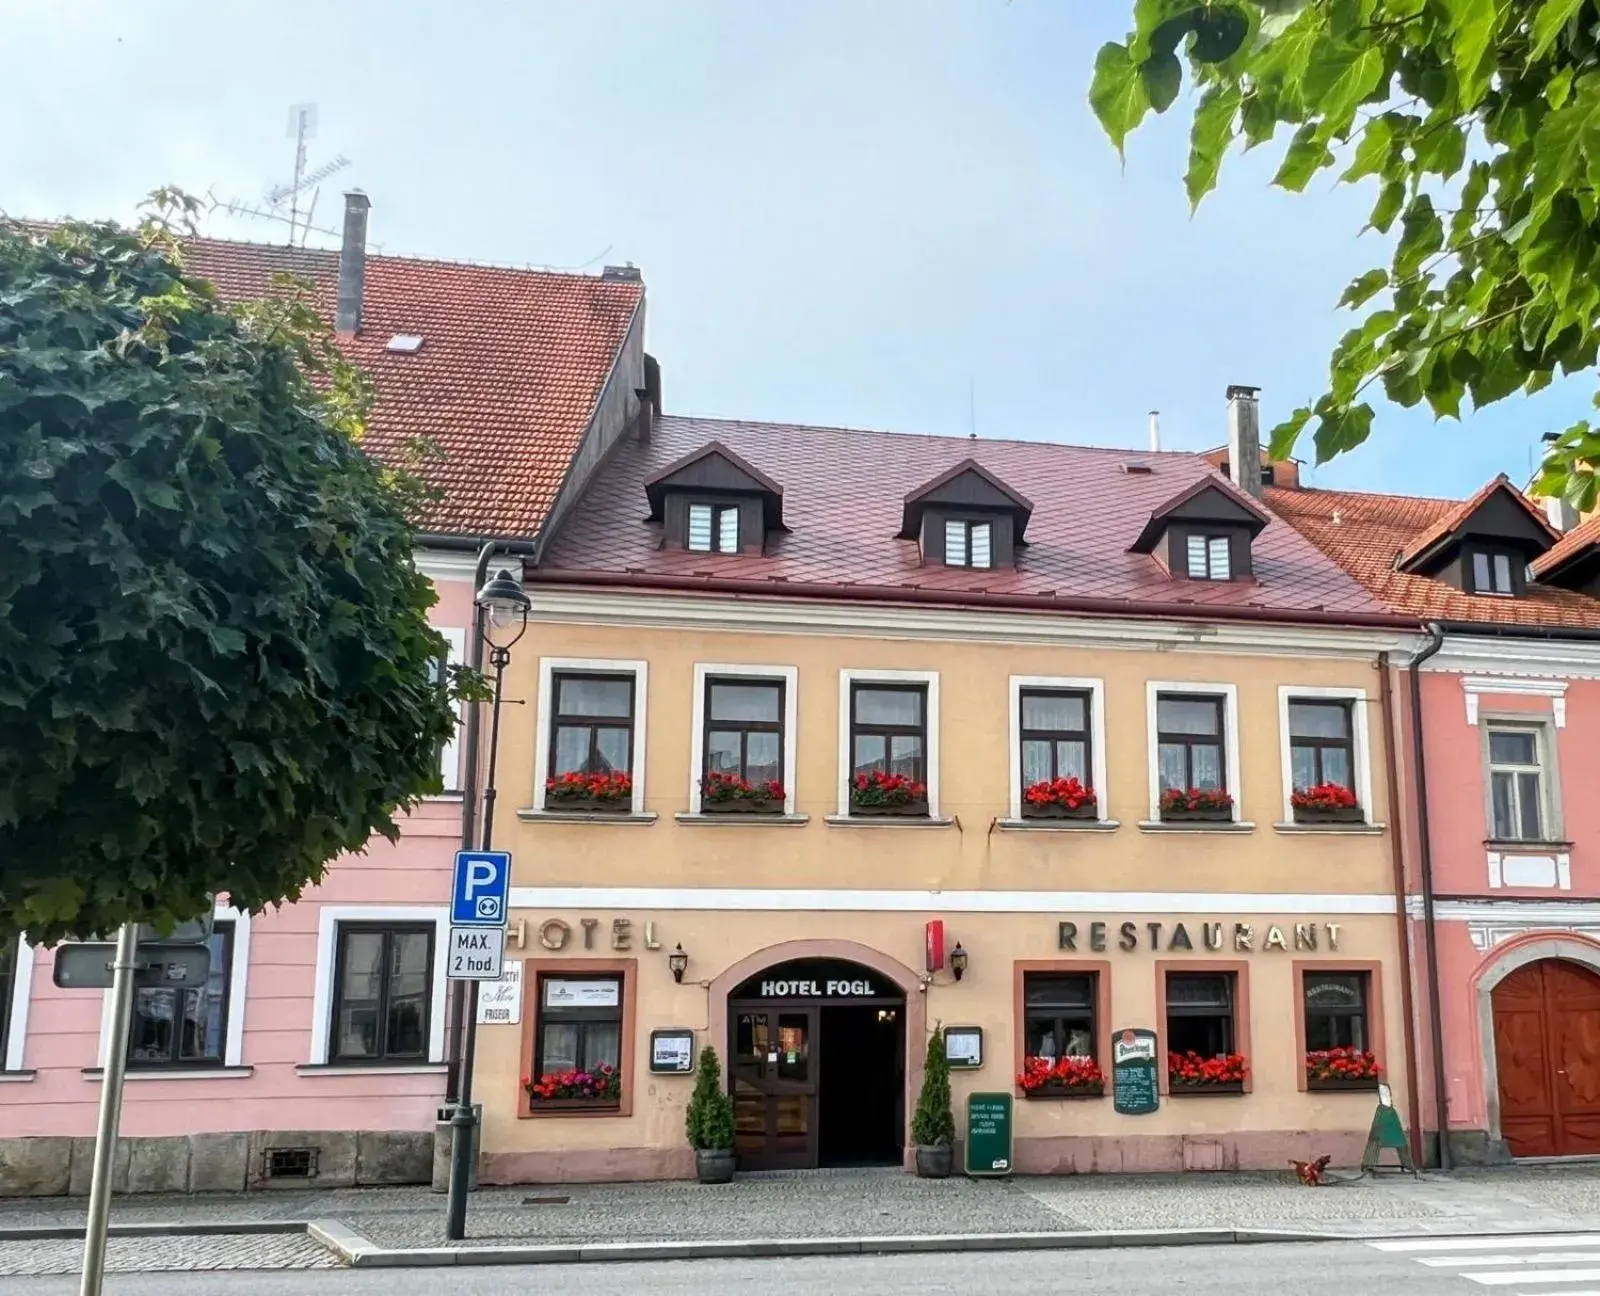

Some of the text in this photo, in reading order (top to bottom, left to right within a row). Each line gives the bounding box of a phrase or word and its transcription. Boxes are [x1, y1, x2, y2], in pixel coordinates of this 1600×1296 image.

[464, 860, 497, 901] P
[457, 934, 491, 950] MAX.
[506, 918, 662, 950] HOTEL
[1058, 920, 1344, 951] RESTAURANT
[454, 956, 495, 971] 2 hod.
[761, 980, 875, 996] HOTEL FOGL
